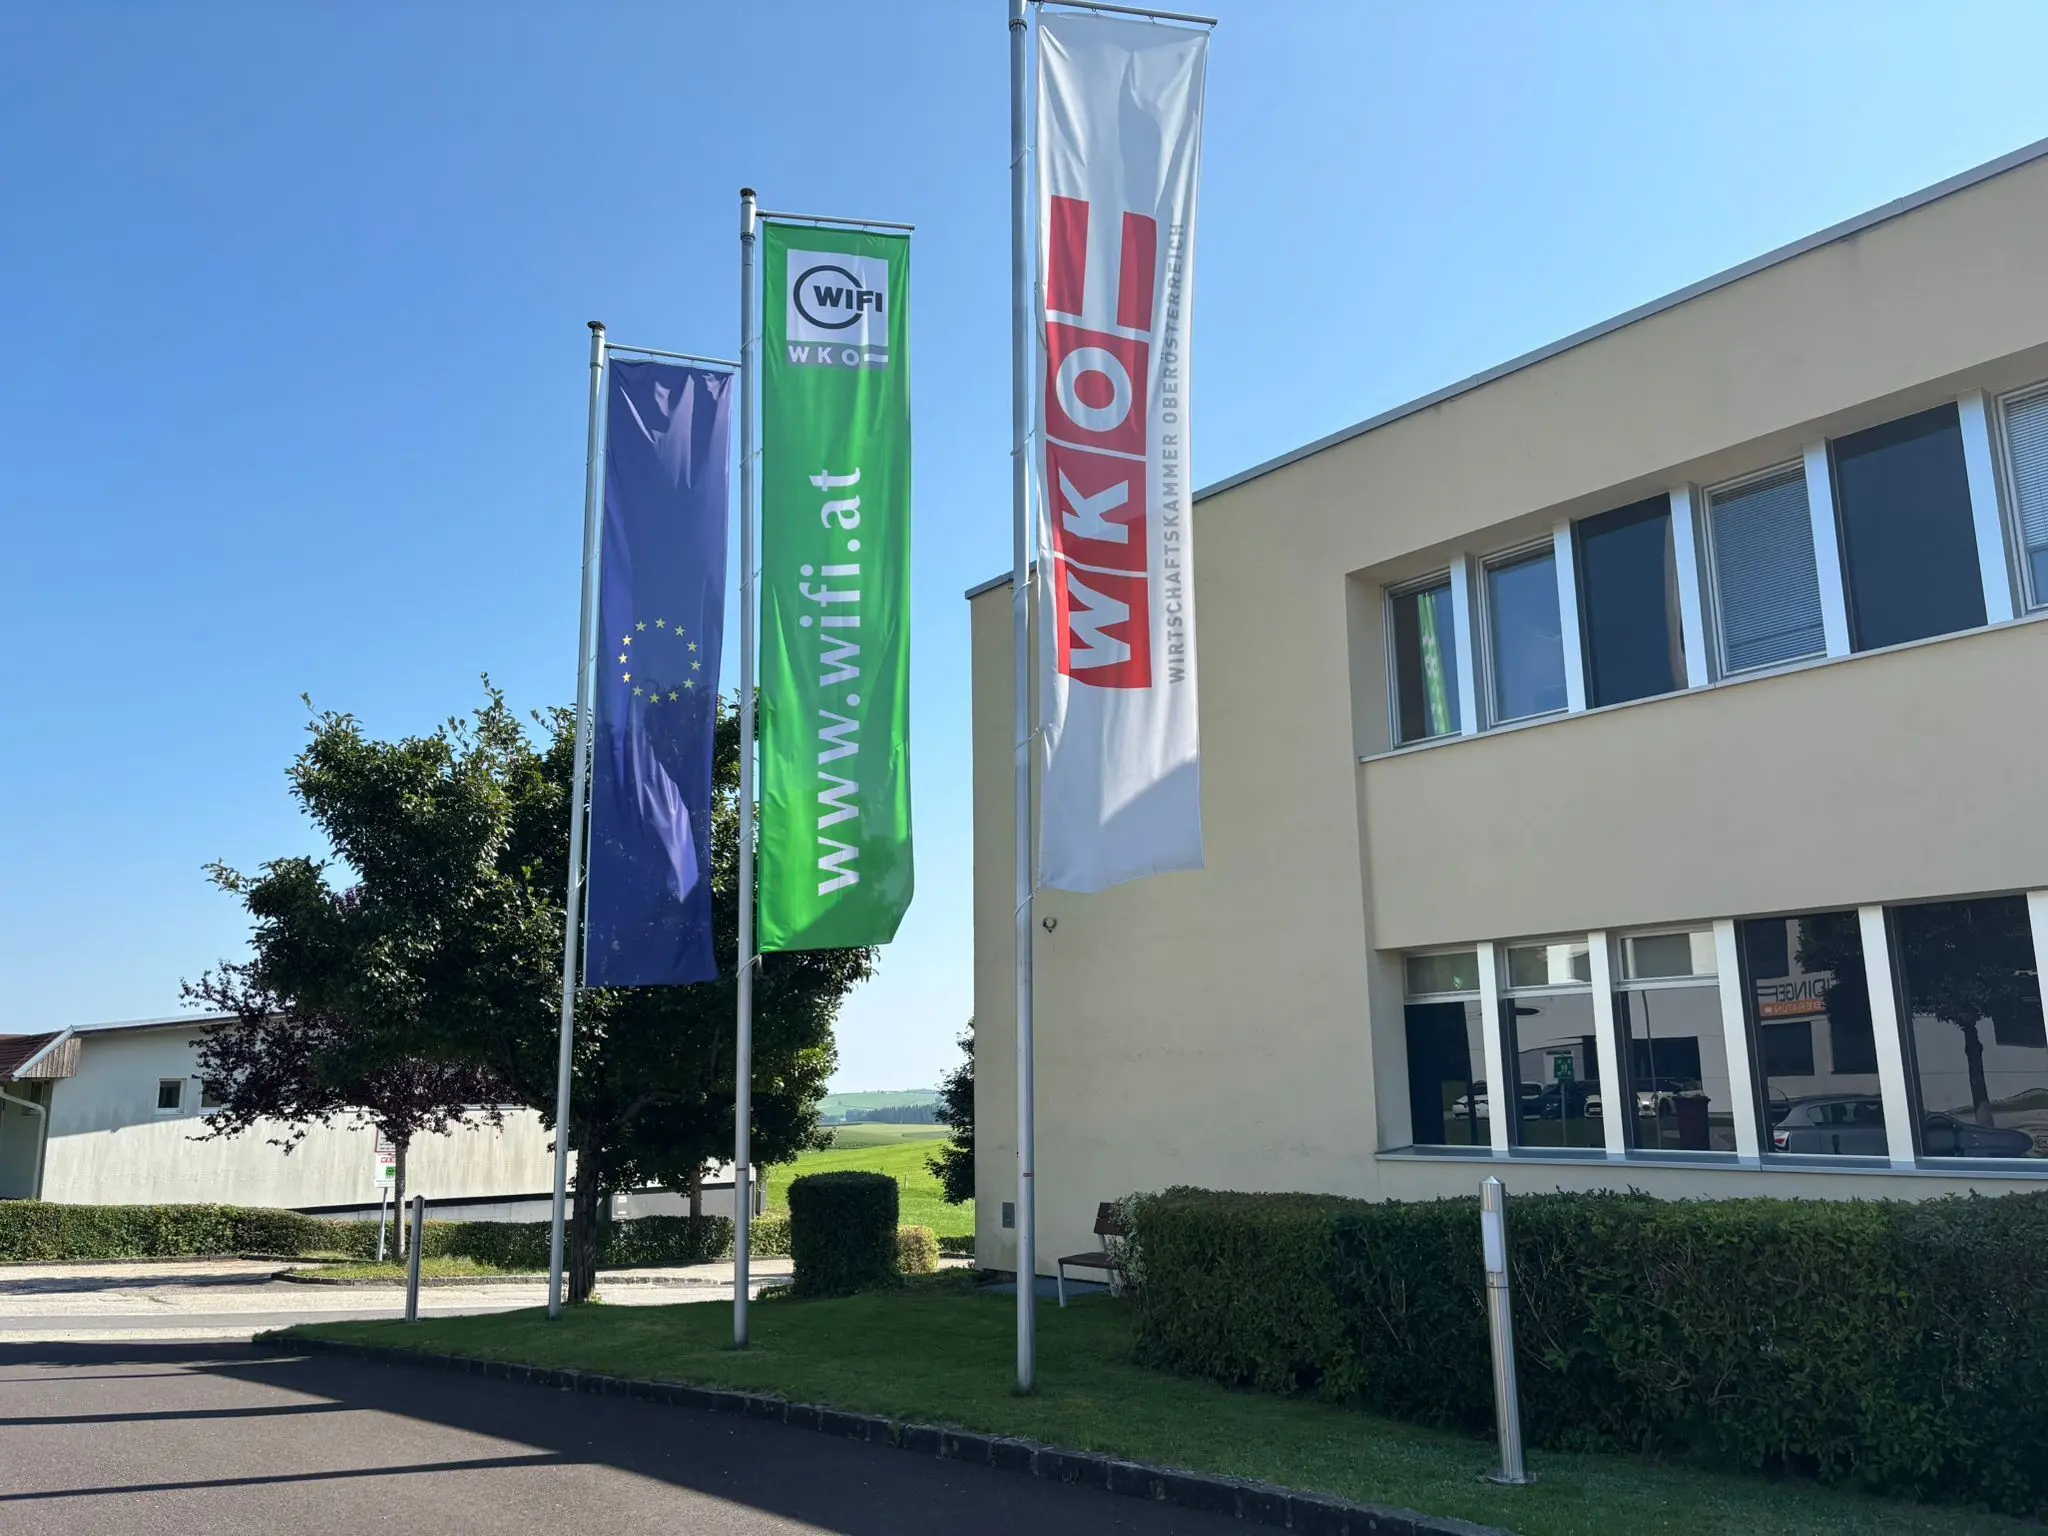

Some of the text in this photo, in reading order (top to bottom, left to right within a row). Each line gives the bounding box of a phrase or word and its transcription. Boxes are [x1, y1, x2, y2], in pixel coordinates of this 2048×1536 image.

[813, 285, 883, 312] WIFI
[1161, 224, 1185, 684] WIRTSCHAFTSKAMMER OBERÖSTERREICH
[799, 467, 861, 896] www.wifi.at
